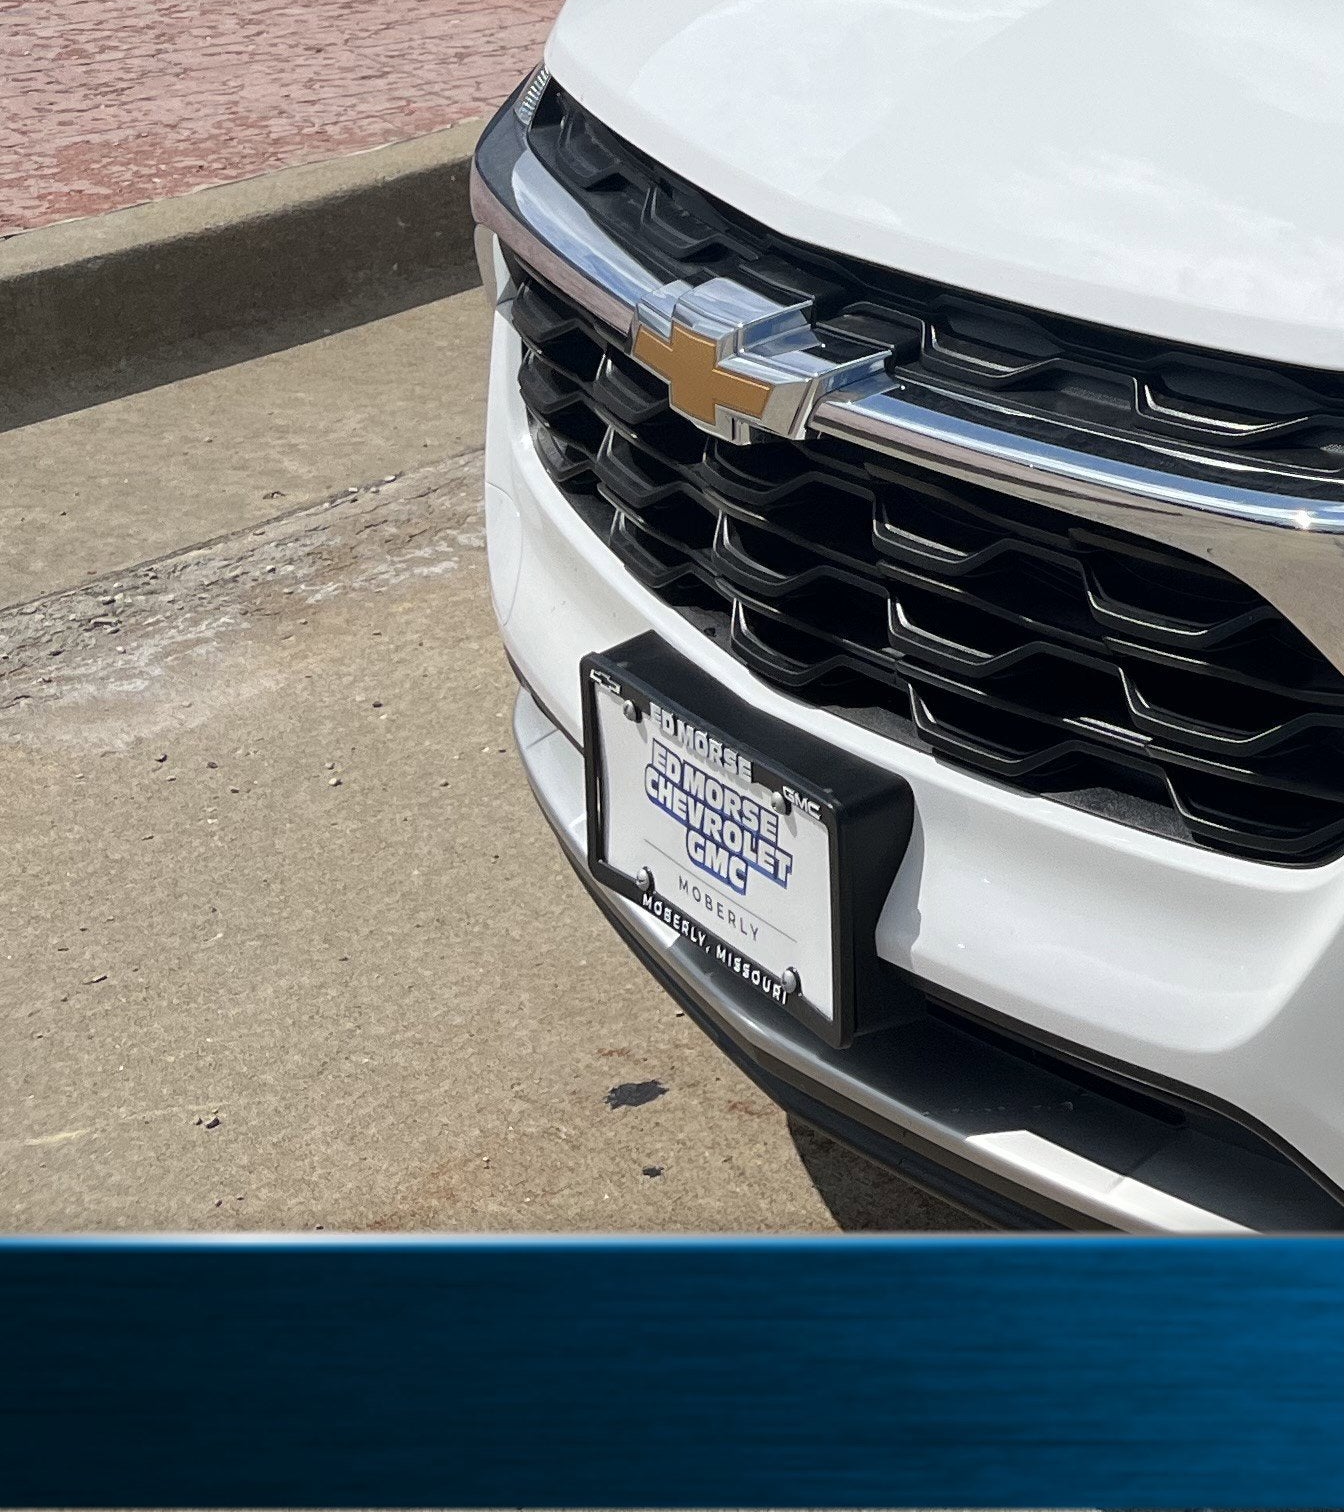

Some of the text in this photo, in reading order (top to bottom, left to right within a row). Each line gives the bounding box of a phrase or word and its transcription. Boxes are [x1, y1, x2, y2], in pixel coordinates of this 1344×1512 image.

[650, 701, 752, 784] ED MORSE
[645, 763, 793, 888] CHEVROLET
[651, 738, 779, 846] ED MORSE
[782, 786, 821, 820] GMC
[686, 828, 748, 895] GMC
[642, 893, 787, 1005] MOBERLY, MISSOURI
[678, 875, 759, 941] MOBERLY
